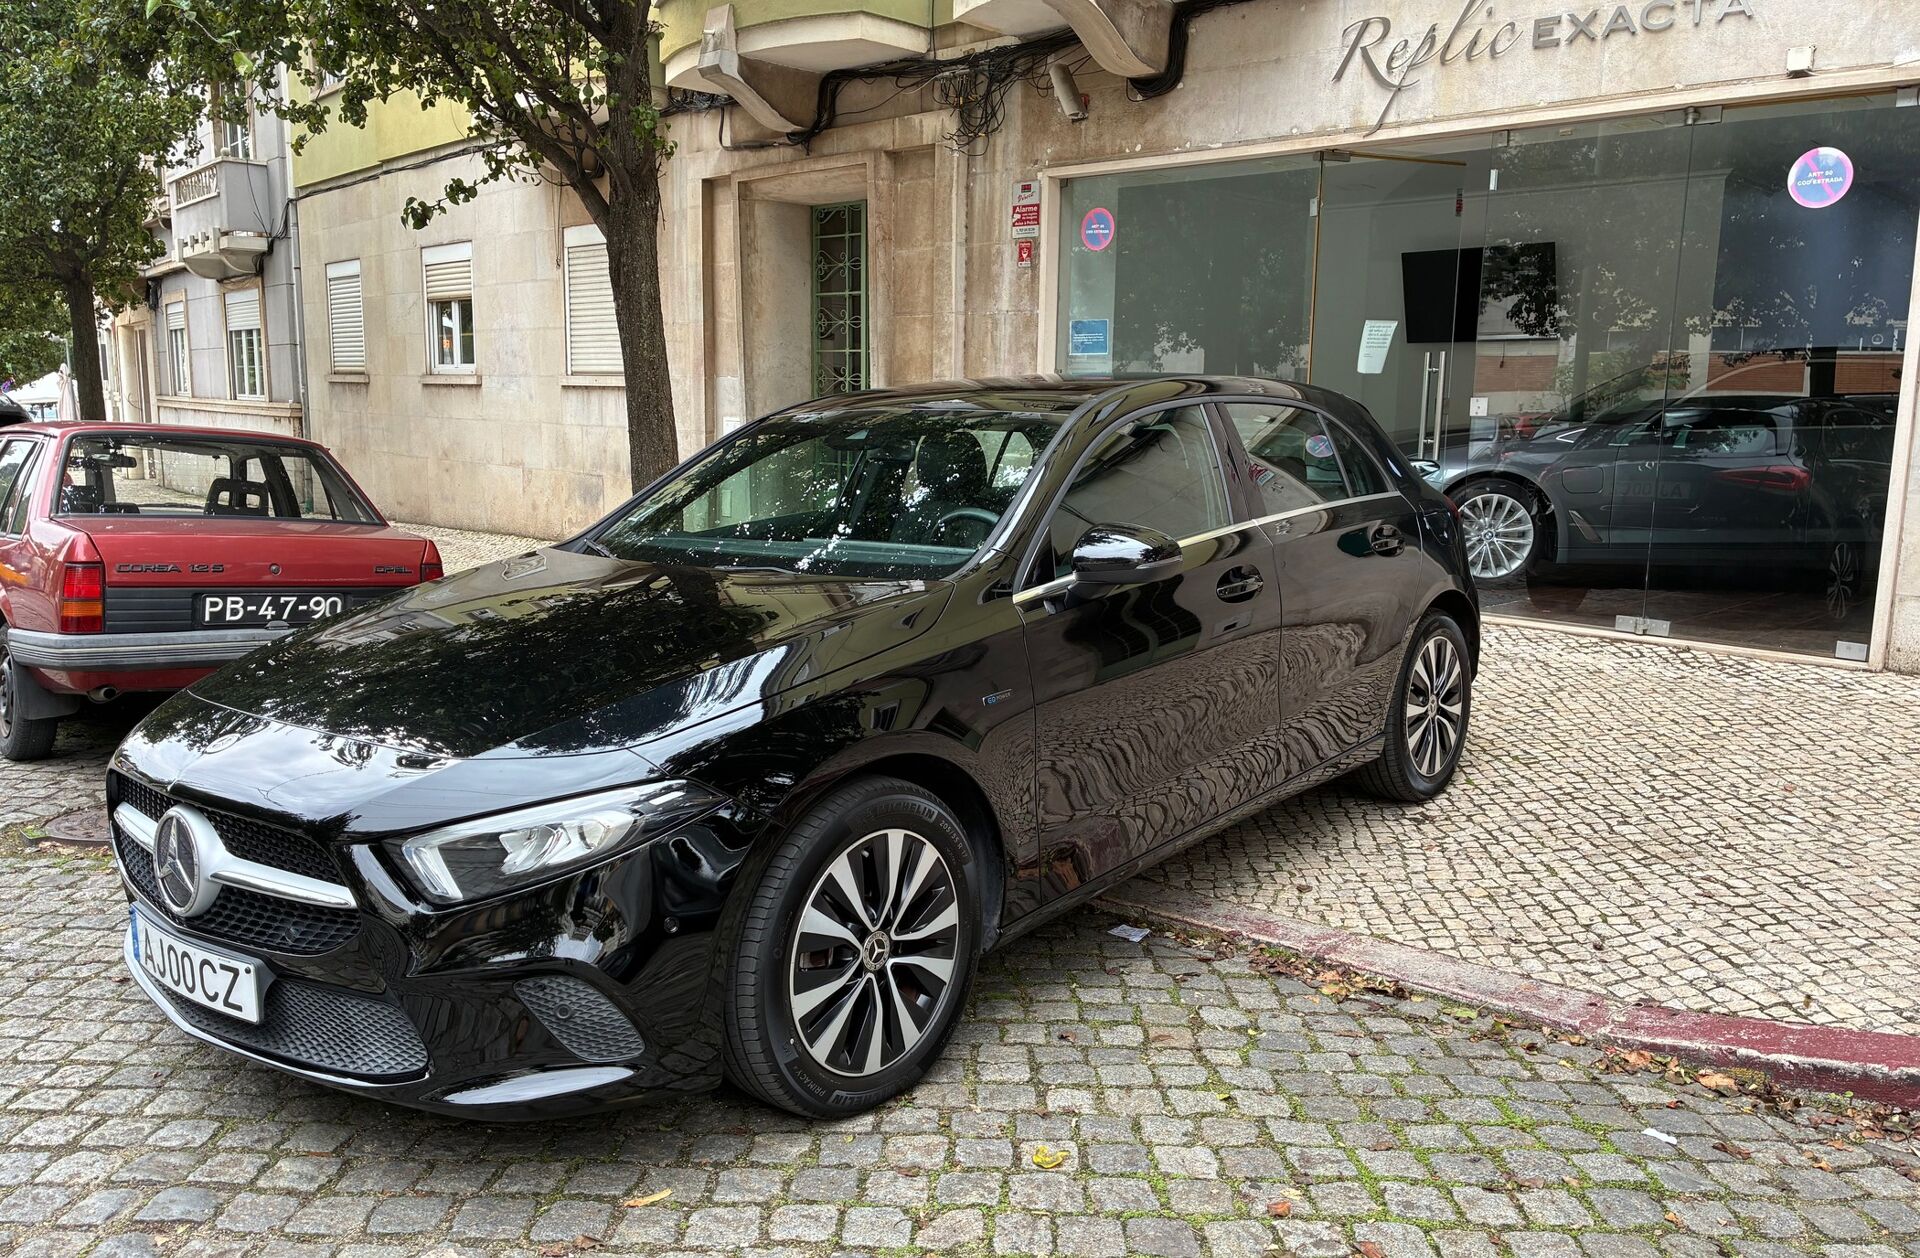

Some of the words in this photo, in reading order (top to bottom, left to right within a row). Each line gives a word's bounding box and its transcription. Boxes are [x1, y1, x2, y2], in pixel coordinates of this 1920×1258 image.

[1331, 0, 1524, 139] Replic
[1532, 0, 1754, 49] EXACTA
[1015, 205, 1038, 213] Alarme
[116, 563, 182, 574] CORSA
[374, 565, 413, 575] OPEL
[204, 596, 342, 622] PB-47-90
[795, 1069, 826, 1097] PRIMACY
